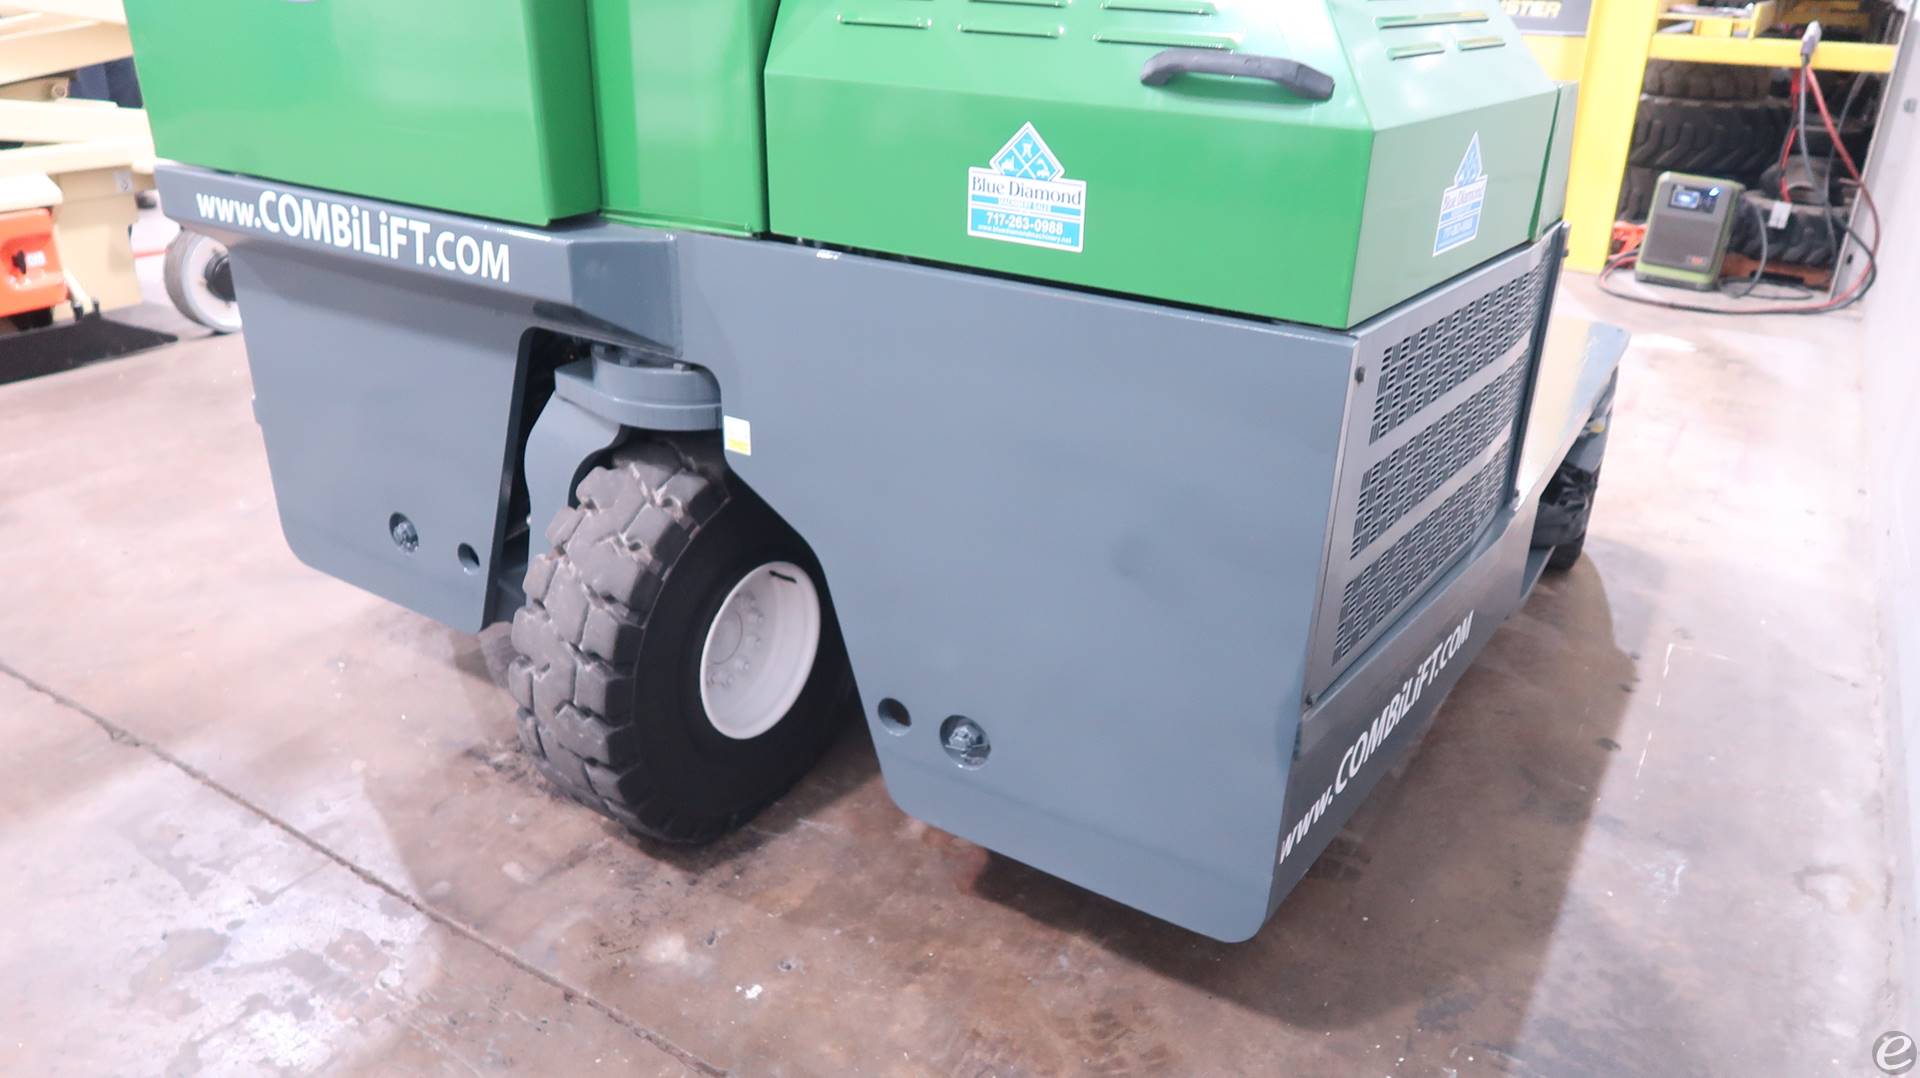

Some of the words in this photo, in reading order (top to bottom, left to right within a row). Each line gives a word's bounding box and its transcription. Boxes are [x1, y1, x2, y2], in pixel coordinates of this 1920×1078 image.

[1500, 0, 1562, 18] STER
[972, 175, 1005, 196] Blue
[1008, 180, 1082, 206] Diamond
[986, 211, 1064, 236] 717-263-0988
